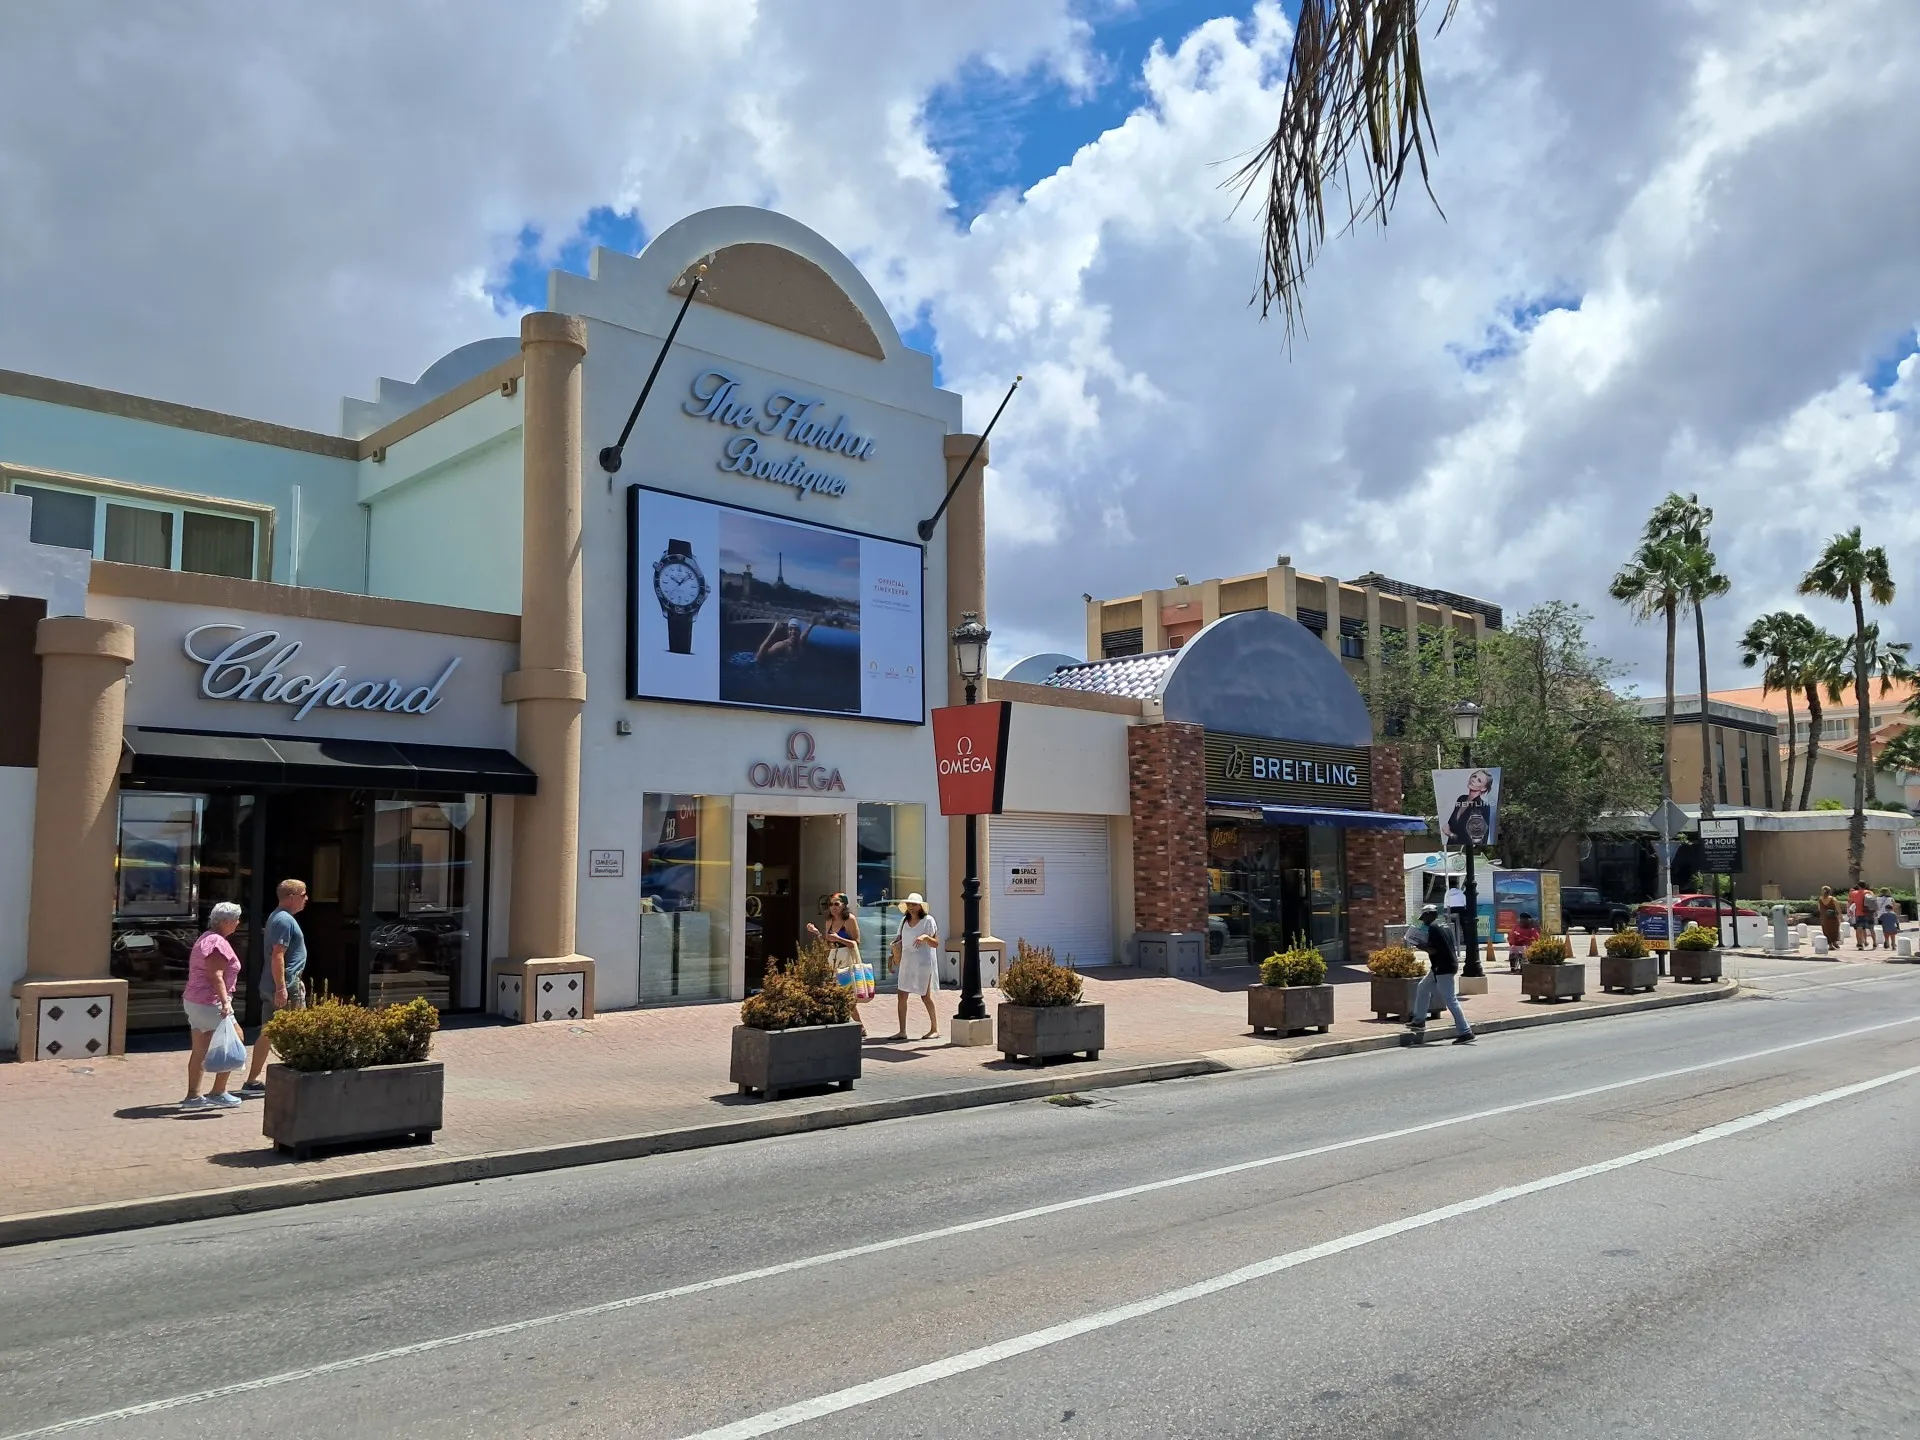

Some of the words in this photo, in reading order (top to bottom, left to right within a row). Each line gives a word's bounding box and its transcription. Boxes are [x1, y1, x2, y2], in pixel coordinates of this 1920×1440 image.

[683, 371, 756, 429] The
[757, 391, 877, 461] Harbor
[874, 585, 909, 596] TIMEKEEPER
[877, 577, 905, 588] OFFICIAL
[184, 623, 463, 721] Chopard
[750, 762, 846, 792] OMEGA
[939, 756, 992, 775] OMEGA
[1253, 756, 1358, 787] BREITLING
[1452, 800, 1496, 808] REITLING
